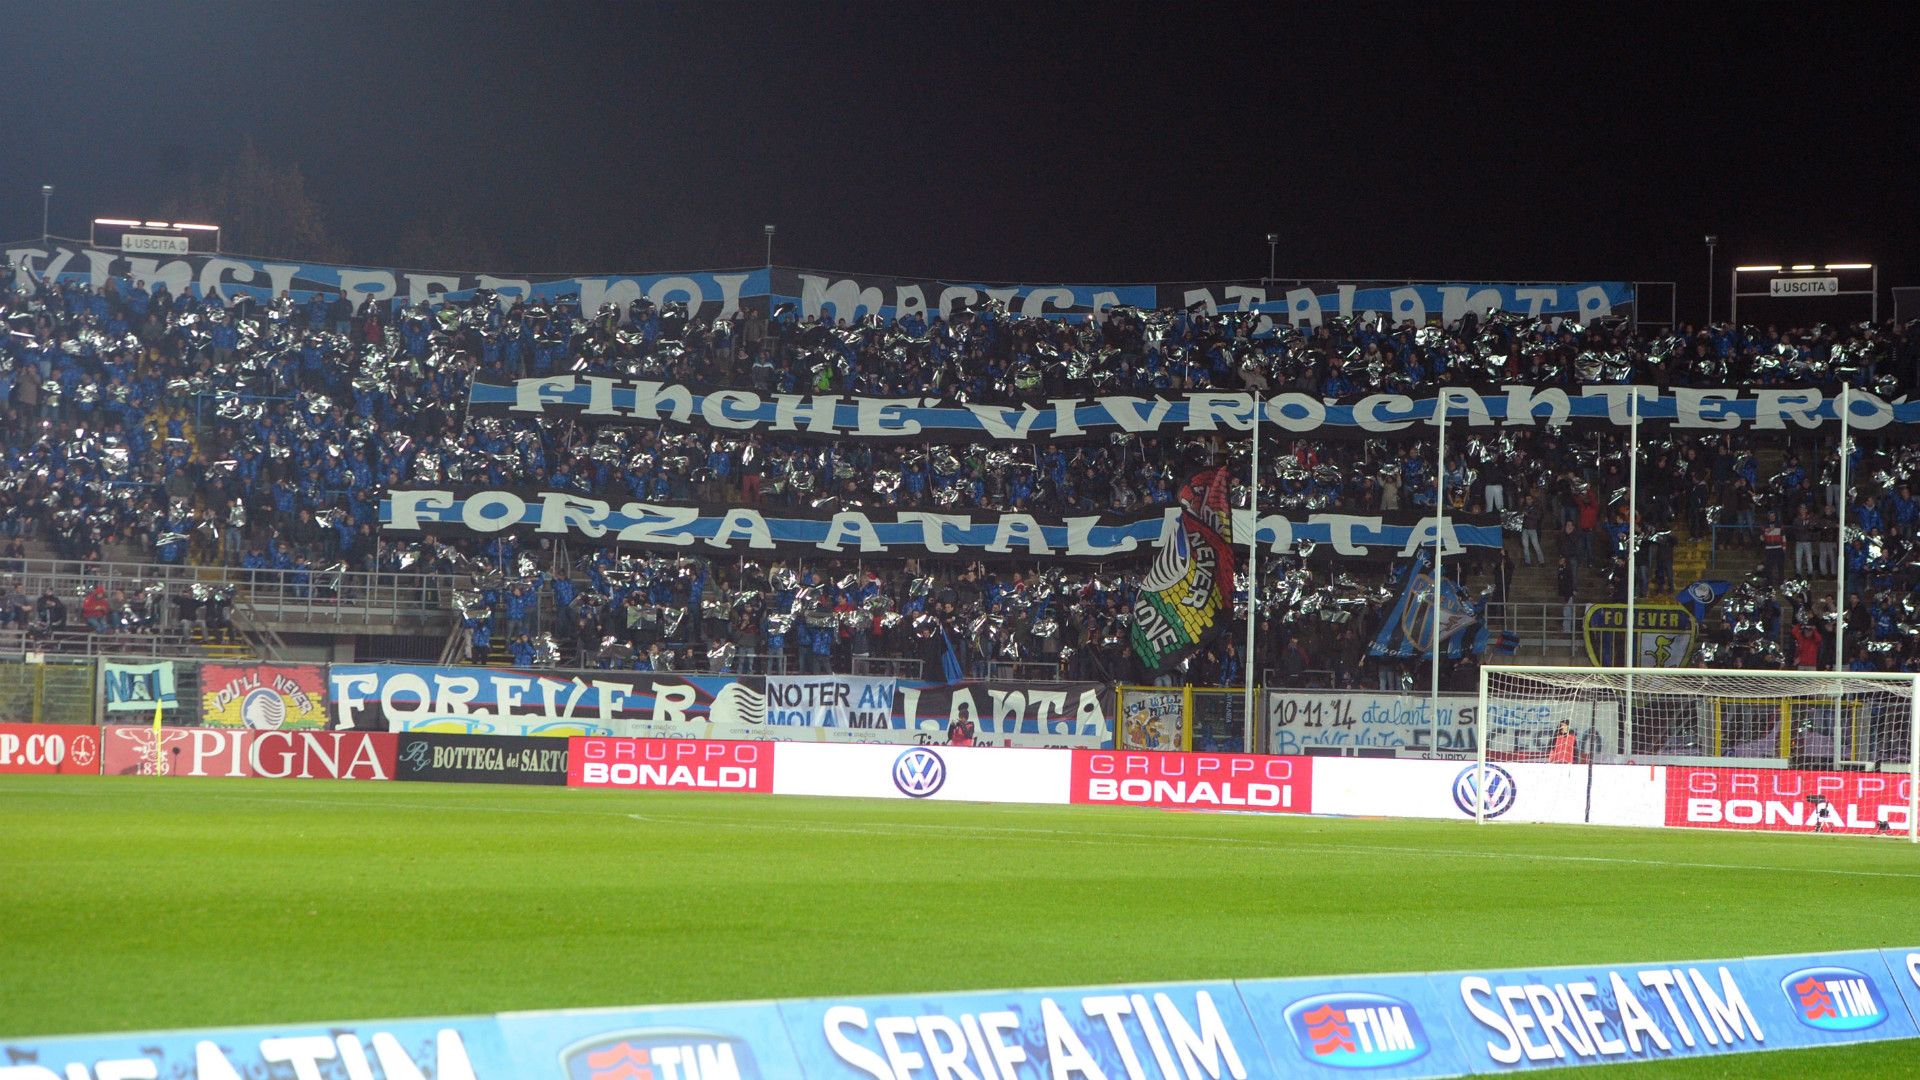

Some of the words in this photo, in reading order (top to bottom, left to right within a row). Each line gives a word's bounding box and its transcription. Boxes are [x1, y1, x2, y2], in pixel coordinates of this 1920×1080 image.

[135, 238, 176, 250] USCITA
[1783, 281, 1826, 293] USCITA
[382, 489, 777, 550] FORZA
[1181, 531, 1216, 609] NEVER
[1604, 611, 1679, 627] FOEVER
[211, 671, 261, 714] YOU'LL
[272, 673, 314, 716] NEVER
[331, 672, 704, 731] FOREVER
[767, 682, 850, 707] NOTER
[858, 684, 893, 708] AN
[848, 711, 888, 729] MIA
[1361, 699, 1453, 726] atalantni
[0, 733, 65, 765] P.CO
[187, 730, 387, 781] PIGNA
[432, 746, 504, 771] BOTTEGA
[507, 753, 519, 768] del
[521, 749, 568, 773] SARTO
[584, 740, 758, 763] GRUPPO
[583, 762, 757, 788] BONALDI
[1089, 754, 1293, 780] GRUPPO
[1088, 778, 1292, 807] BONALDI
[1687, 797, 1911, 831] BONALD
[1608, 971, 1672, 1053] A
[1637, 966, 1764, 1047] TIM
[1824, 978, 1879, 1018] TIM
[823, 1006, 1029, 1080] SERIE
[1040, 997, 1107, 1080] A
[1081, 990, 1248, 1080] TIM
[1345, 1006, 1416, 1053] TIM
[1460, 976, 1627, 1063] SERIE
